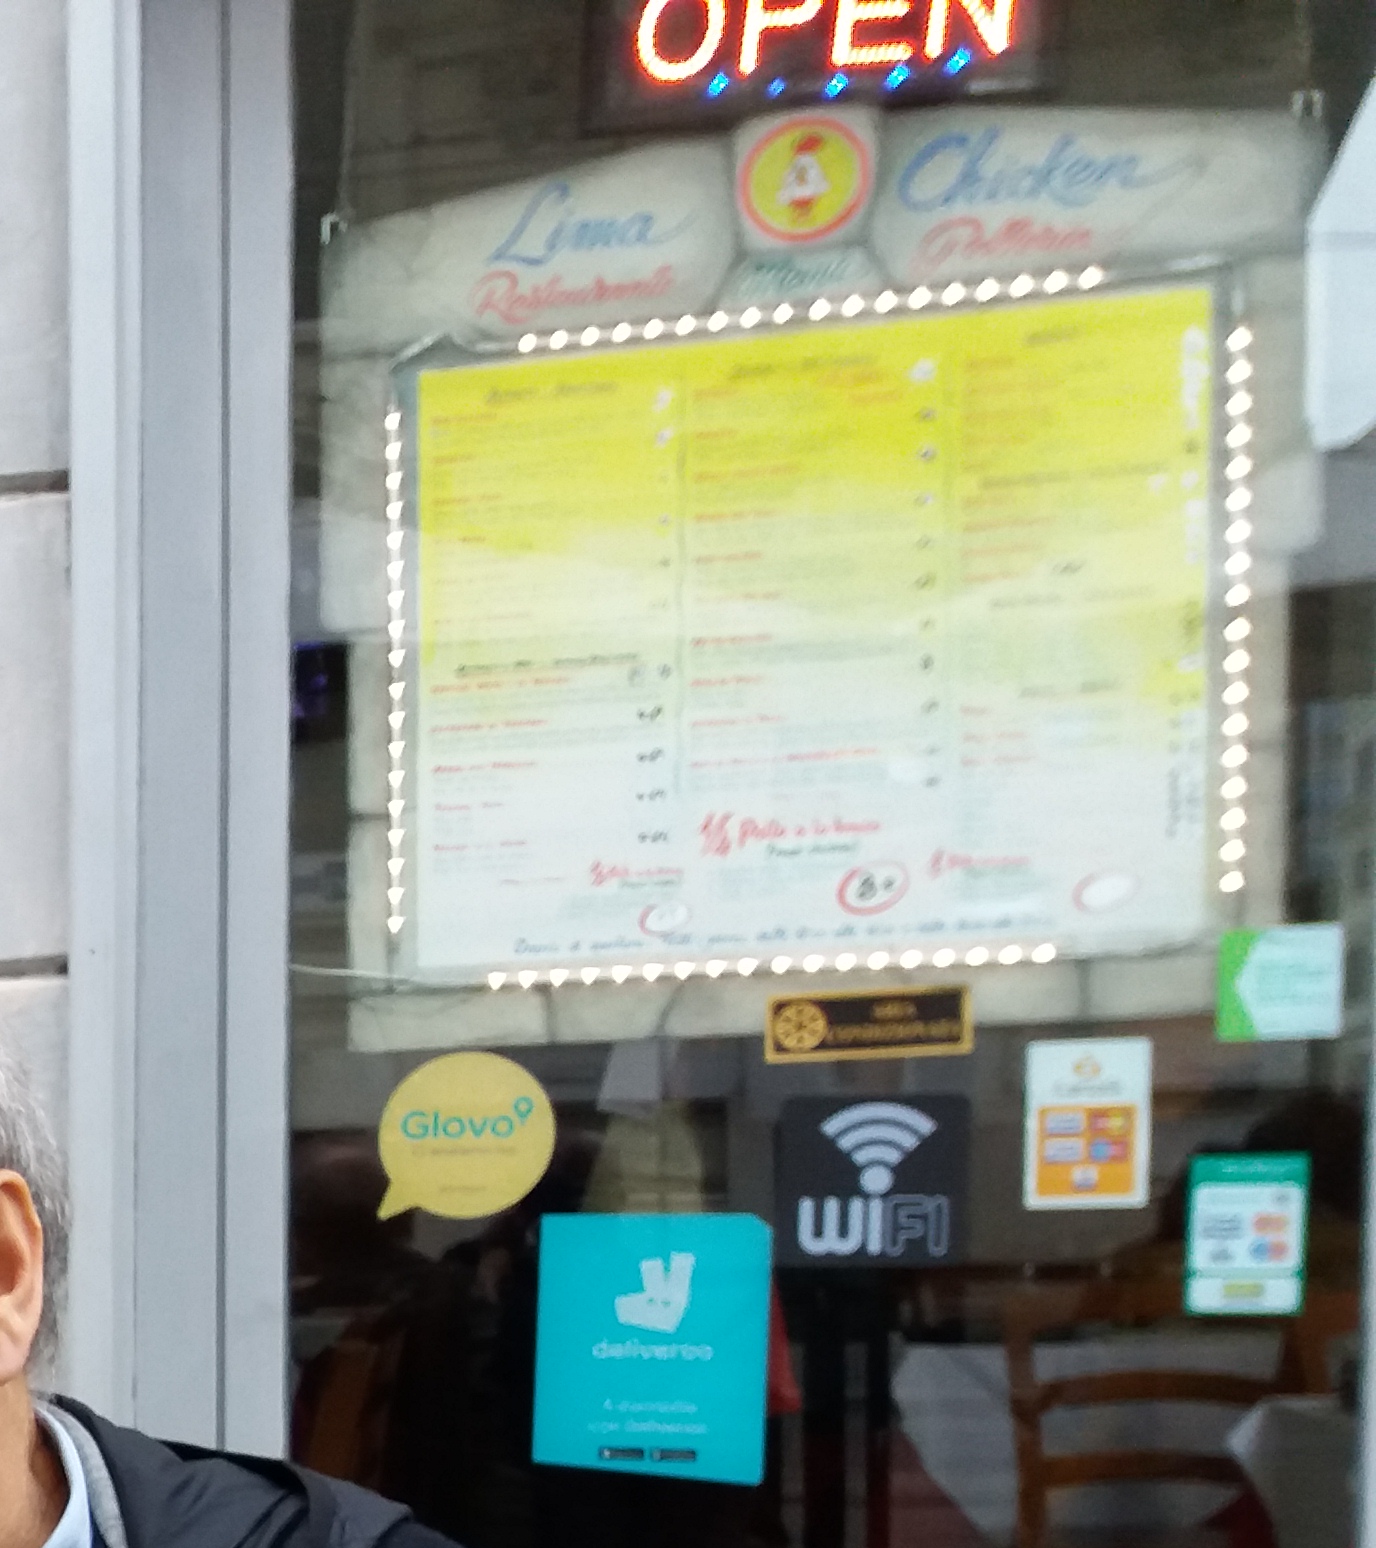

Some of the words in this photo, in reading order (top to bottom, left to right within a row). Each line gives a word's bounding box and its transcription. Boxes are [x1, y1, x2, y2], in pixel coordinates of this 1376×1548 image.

[635, 0, 1015, 83] OPEN
[897, 126, 1142, 208] Chicken
[488, 181, 658, 266] Lima
[400, 1110, 515, 1140] Glovo
[592, 1338, 714, 1361] deliveroo
